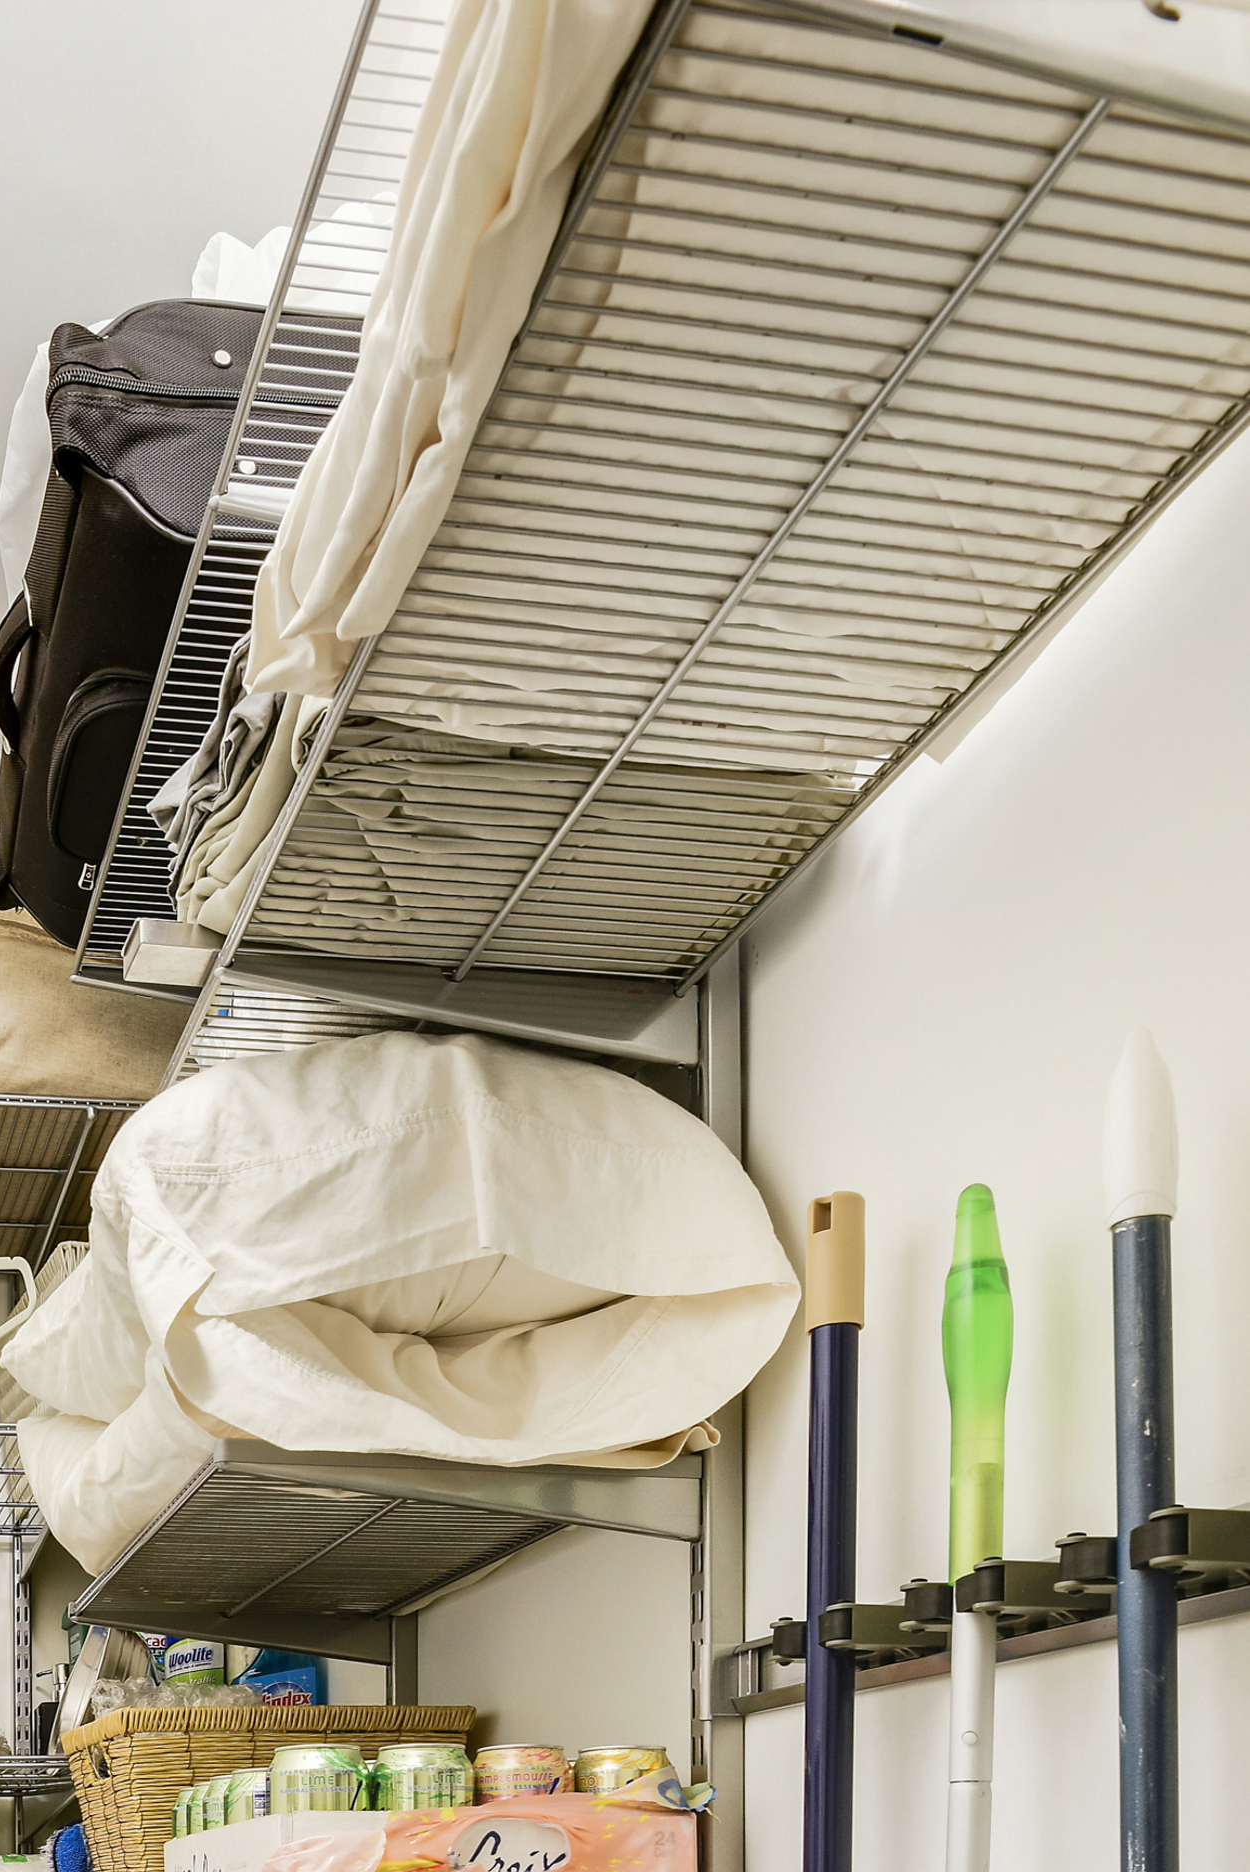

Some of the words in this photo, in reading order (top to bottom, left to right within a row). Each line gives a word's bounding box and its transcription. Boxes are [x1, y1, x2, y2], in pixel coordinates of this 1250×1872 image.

[169, 1647, 213, 1669] Woolite
[262, 1689, 312, 1706] index
[301, 1775, 335, 1786] LIME
[433, 1774, 462, 1784] LIME
[654, 1831, 676, 1846] 24
